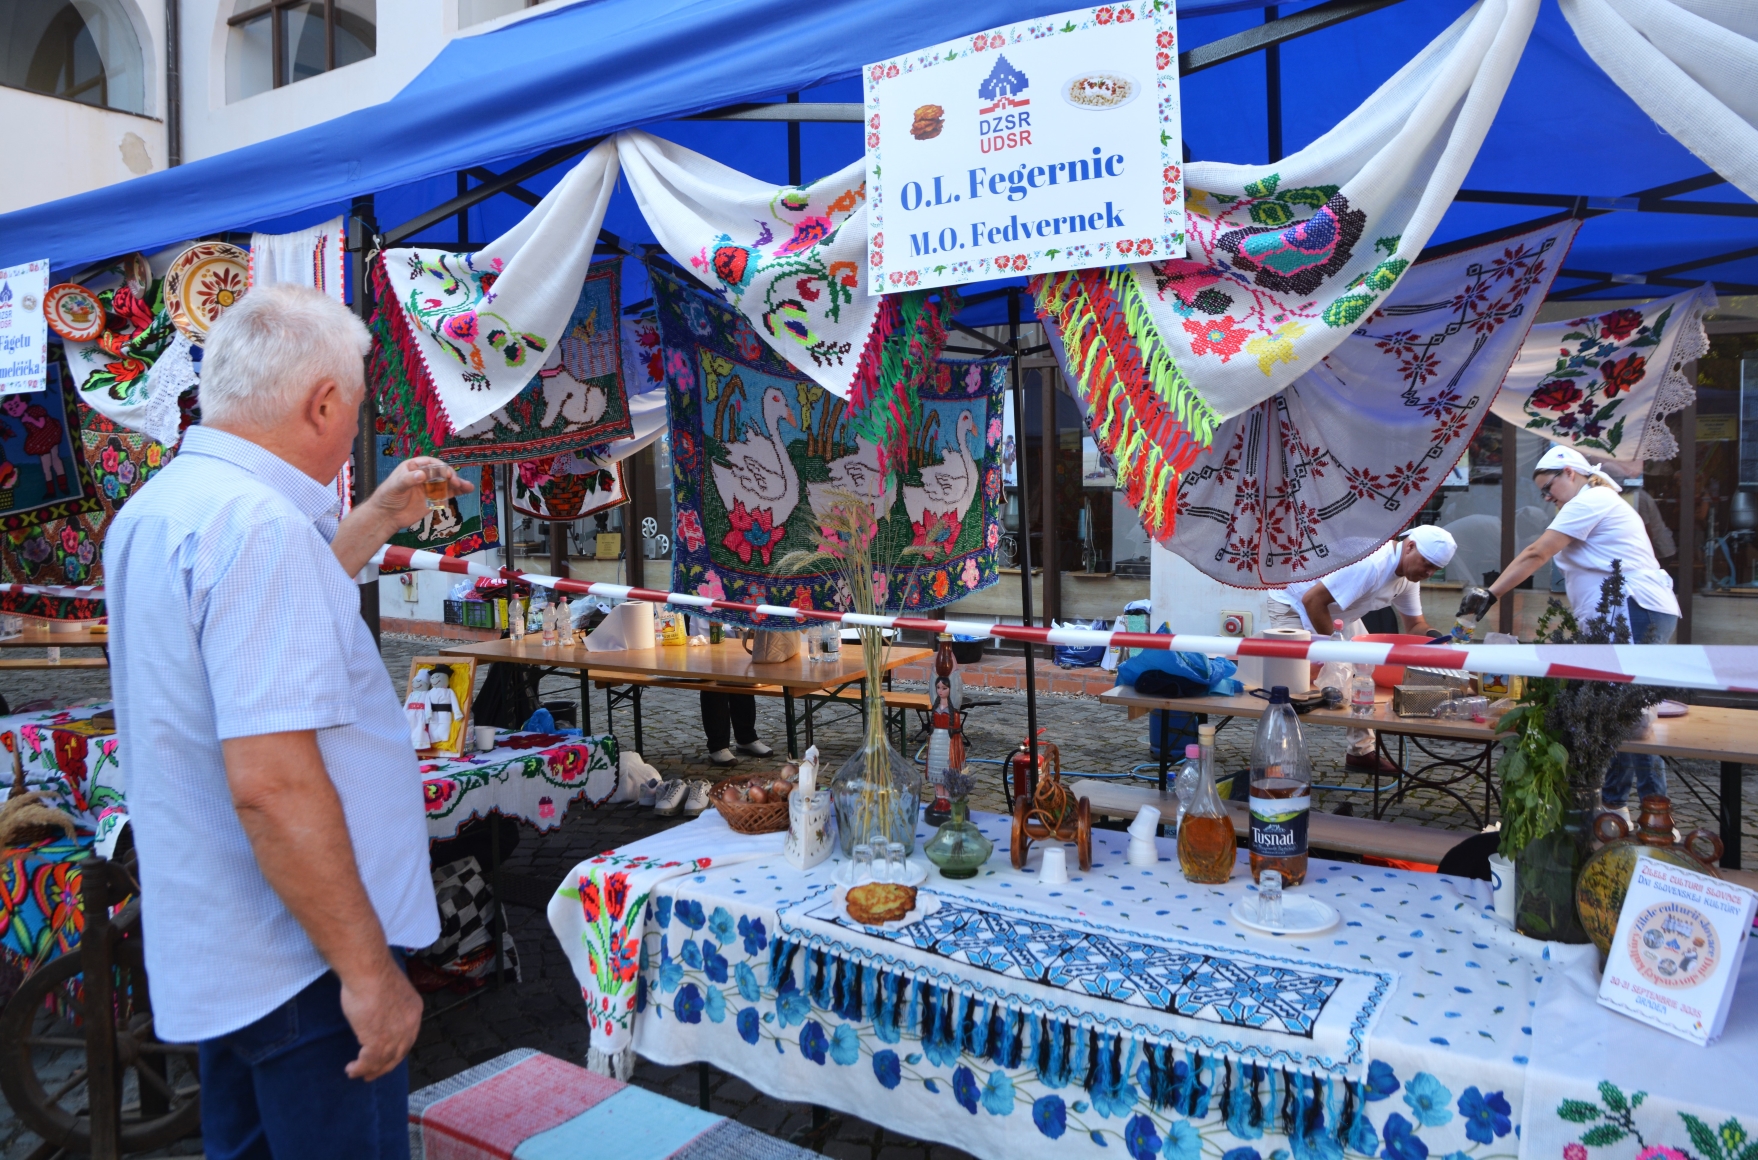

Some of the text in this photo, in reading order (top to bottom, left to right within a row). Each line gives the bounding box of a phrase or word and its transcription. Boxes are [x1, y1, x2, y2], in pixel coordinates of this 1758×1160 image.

[979, 111, 1031, 136] DZSR
[980, 129, 1032, 154] UDSR
[900, 146, 1125, 211] O.L. Fegernic
[909, 201, 1125, 257] M.O. Fedvernek
[0, 310, 12, 319] ZSR
[0, 320, 12, 329] DSR
[0, 359, 40, 379] melčička
[1637, 874, 1651, 887] DNI
[1653, 882, 1702, 902] SLOVENSKEJ
[1641, 865, 1742, 905] ZILELE CULTURII SLOVACE
[1635, 908, 1657, 932] Zilele
[1659, 902, 1701, 921] culturii
[1631, 984, 1678, 1010] SEPTEMBRIE
